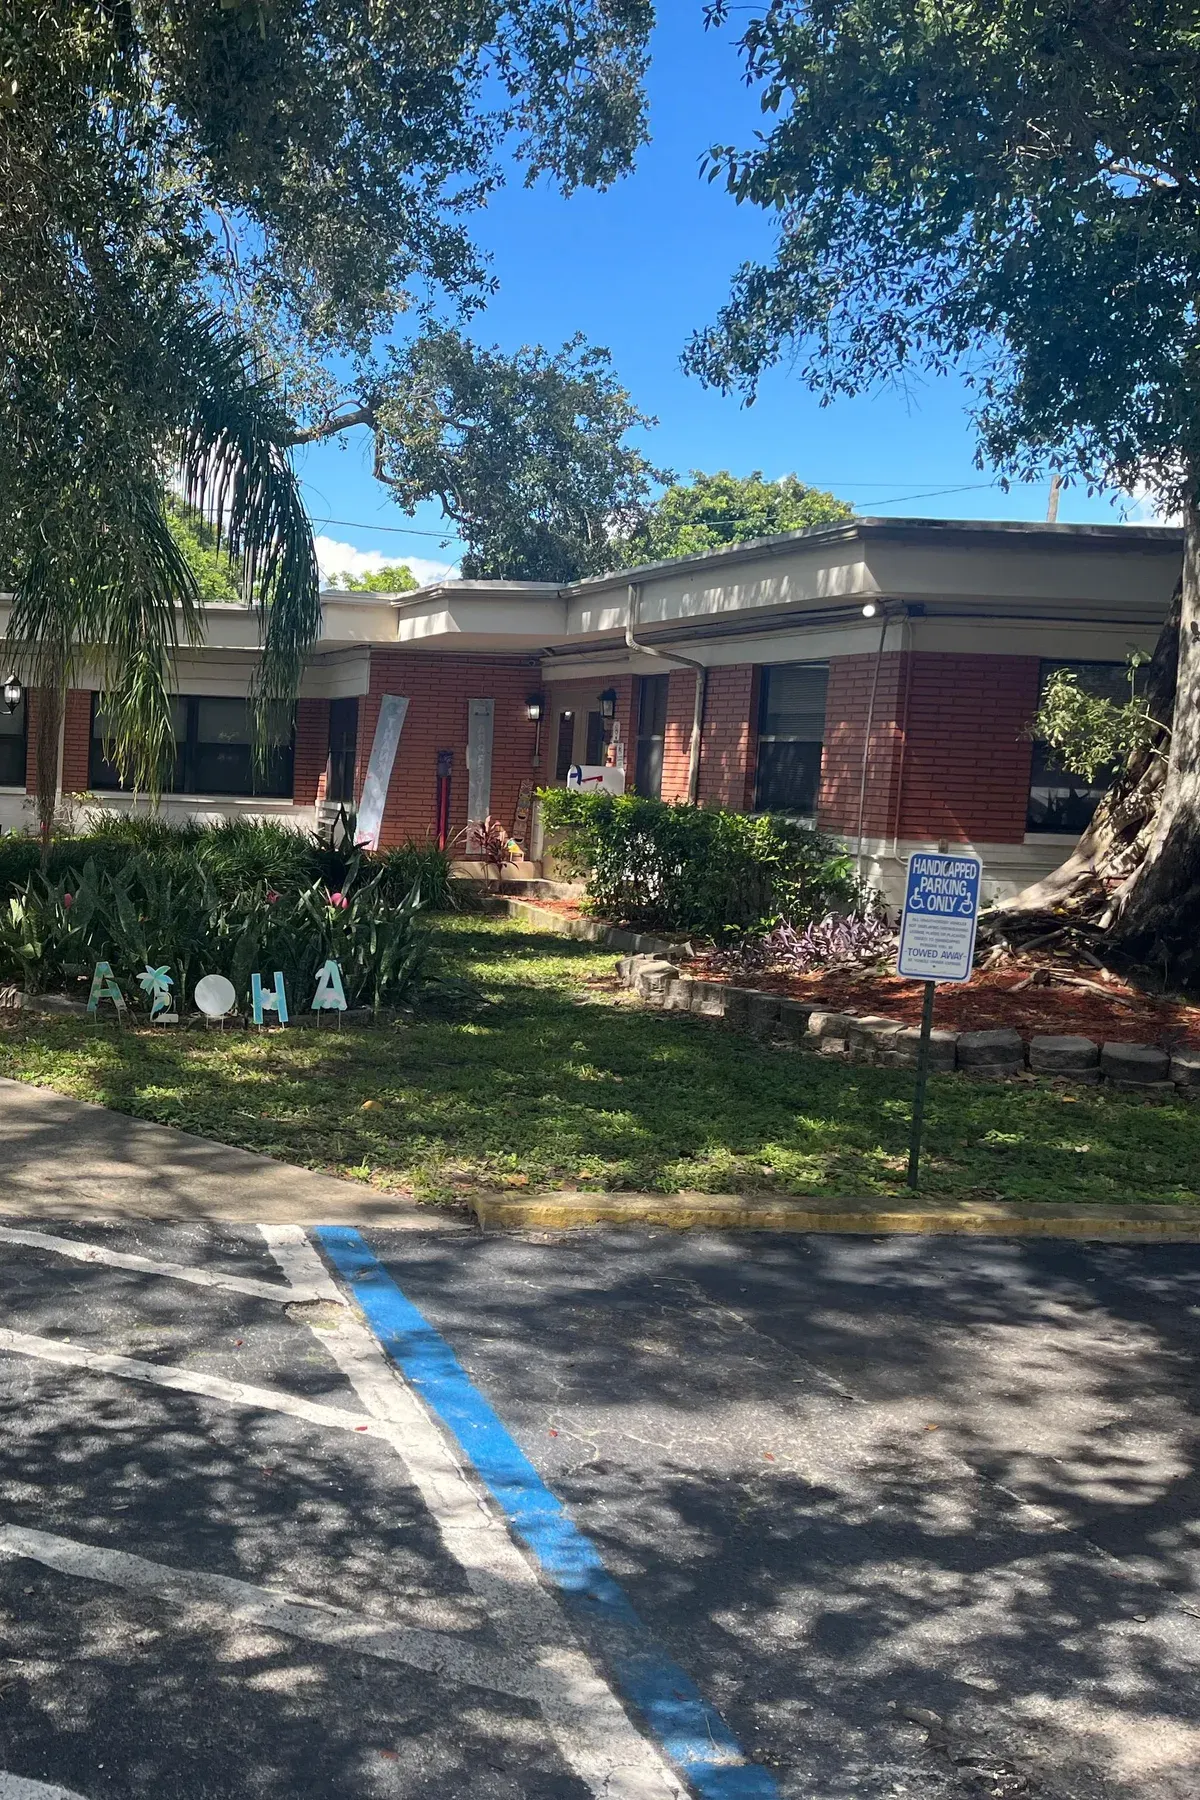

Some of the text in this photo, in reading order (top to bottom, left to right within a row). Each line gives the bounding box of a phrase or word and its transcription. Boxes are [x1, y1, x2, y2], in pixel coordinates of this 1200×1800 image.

[912, 858, 976, 880] HANDICAPPED
[920, 877, 968, 896] PARKING
[927, 895, 958, 913] ONLY
